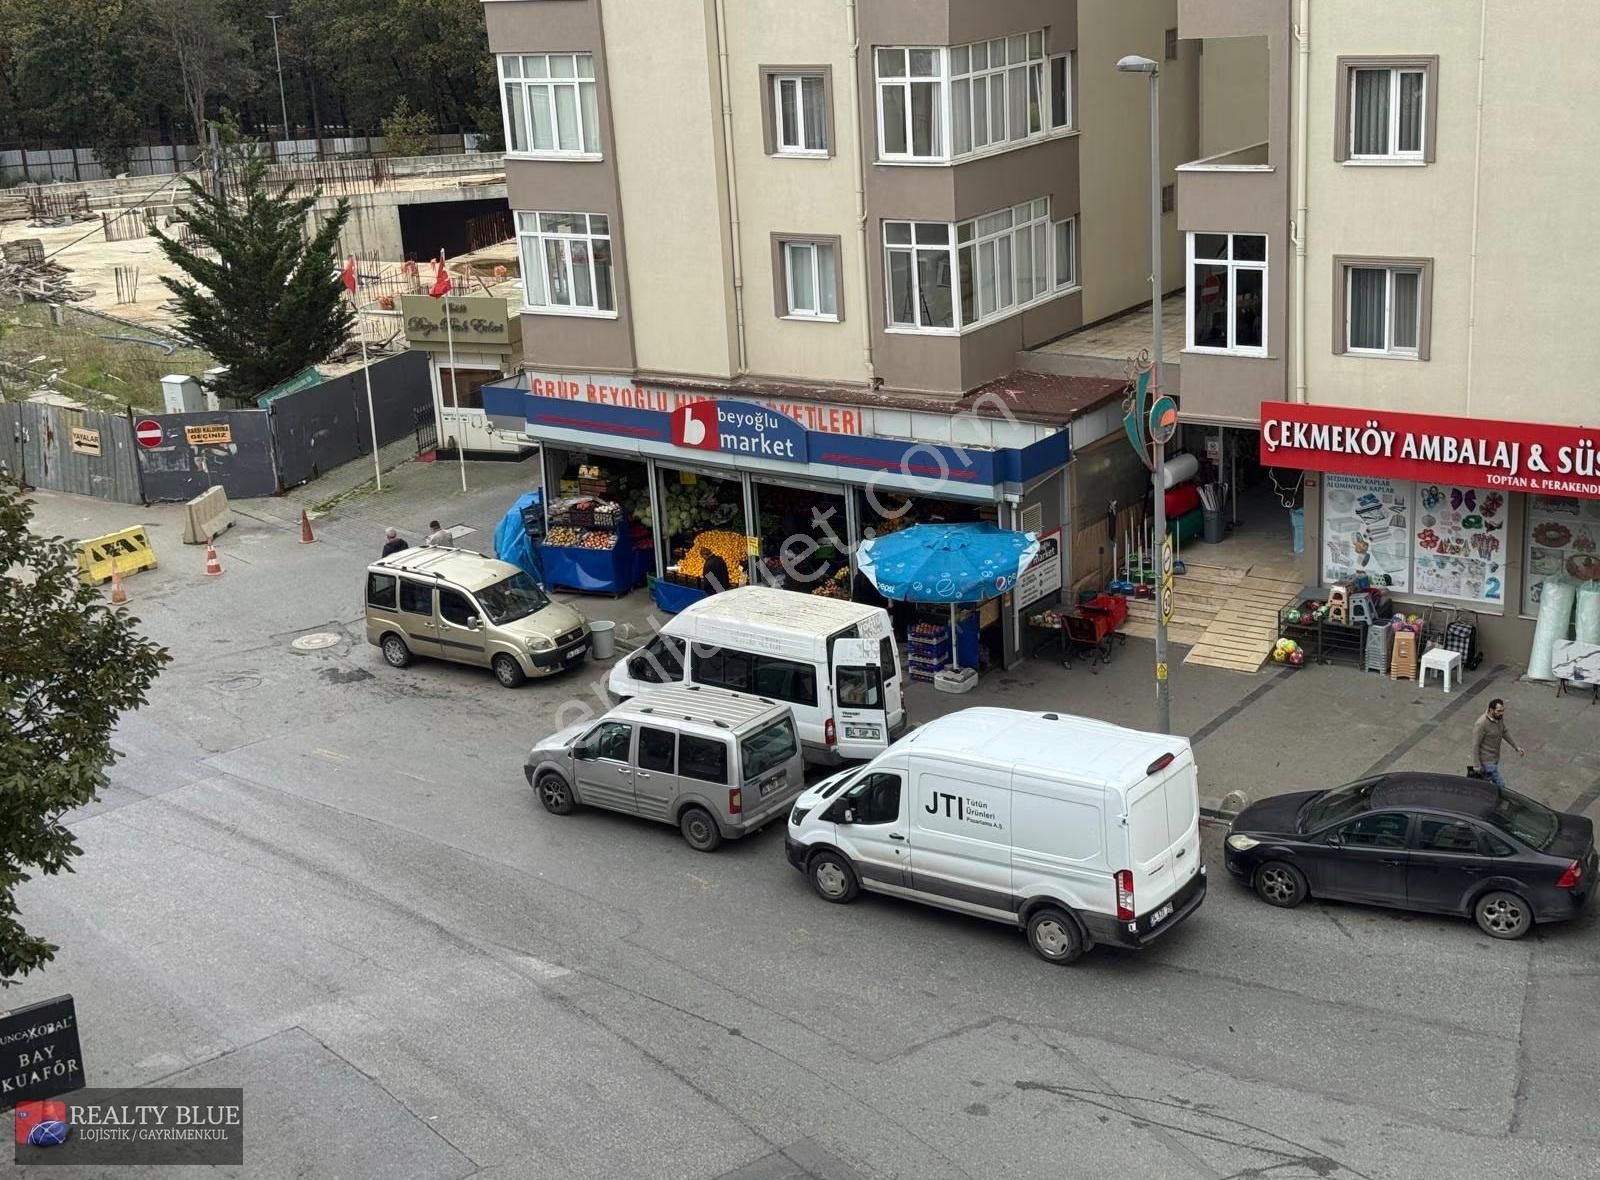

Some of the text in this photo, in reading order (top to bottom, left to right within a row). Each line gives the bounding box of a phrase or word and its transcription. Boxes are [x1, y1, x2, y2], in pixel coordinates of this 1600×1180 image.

[532, 377, 579, 400] GRUP
[587, 382, 668, 411] BEYOĞLU
[683, 407, 706, 446] b
[717, 407, 779, 432] beyoğlu
[72, 431, 99, 443] YAYALAR
[190, 432, 227, 440] GEÇİNİZ
[719, 433, 794, 458] market
[1263, 419, 1396, 458] ÇEKMEKÖY
[1400, 432, 1520, 476] AMBALAJ
[1527, 443, 1551, 473] &
[1486, 474, 1600, 495] TOPTAN & PERAKEND
[925, 791, 963, 820] JTI
[966, 798, 988, 809] Tütün
[966, 806, 995, 820] Ürünleri
[19, 1045, 55, 1067] BAY
[2, 1059, 79, 1093] KUAFÖR
